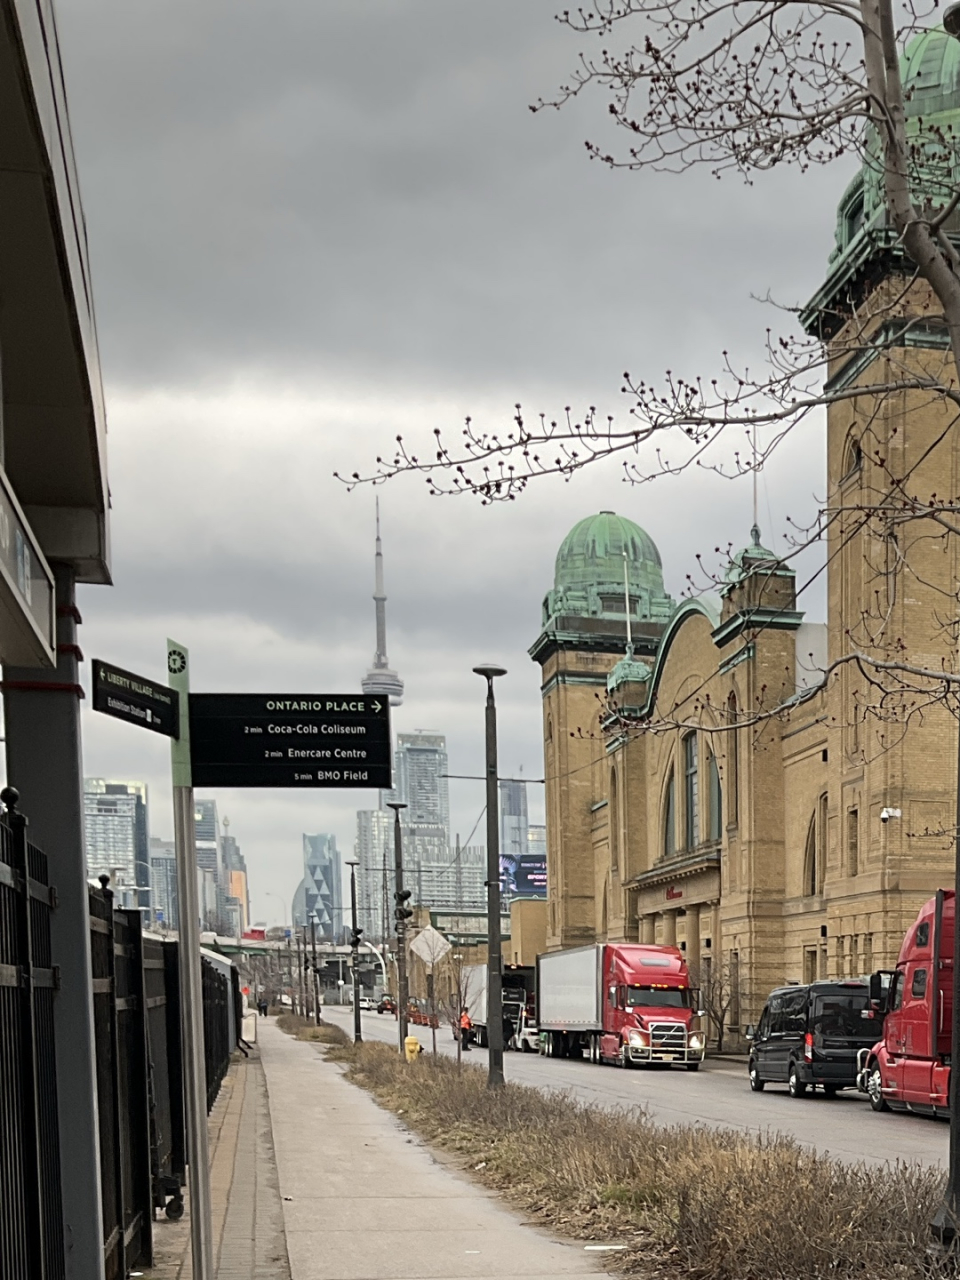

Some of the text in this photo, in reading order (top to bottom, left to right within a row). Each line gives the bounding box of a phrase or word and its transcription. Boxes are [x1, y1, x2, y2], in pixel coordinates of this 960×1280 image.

[107, 672, 153, 697] LIBERTY VILLAGE
[266, 701, 365, 711] ONTARIO PLACE
[267, 724, 318, 734] Coca-Cola
[321, 724, 366, 734] Coliseum
[288, 748, 332, 758] Enercare
[334, 748, 367, 758] Centre
[317, 770, 341, 780] BMO
[343, 770, 368, 780] Field
